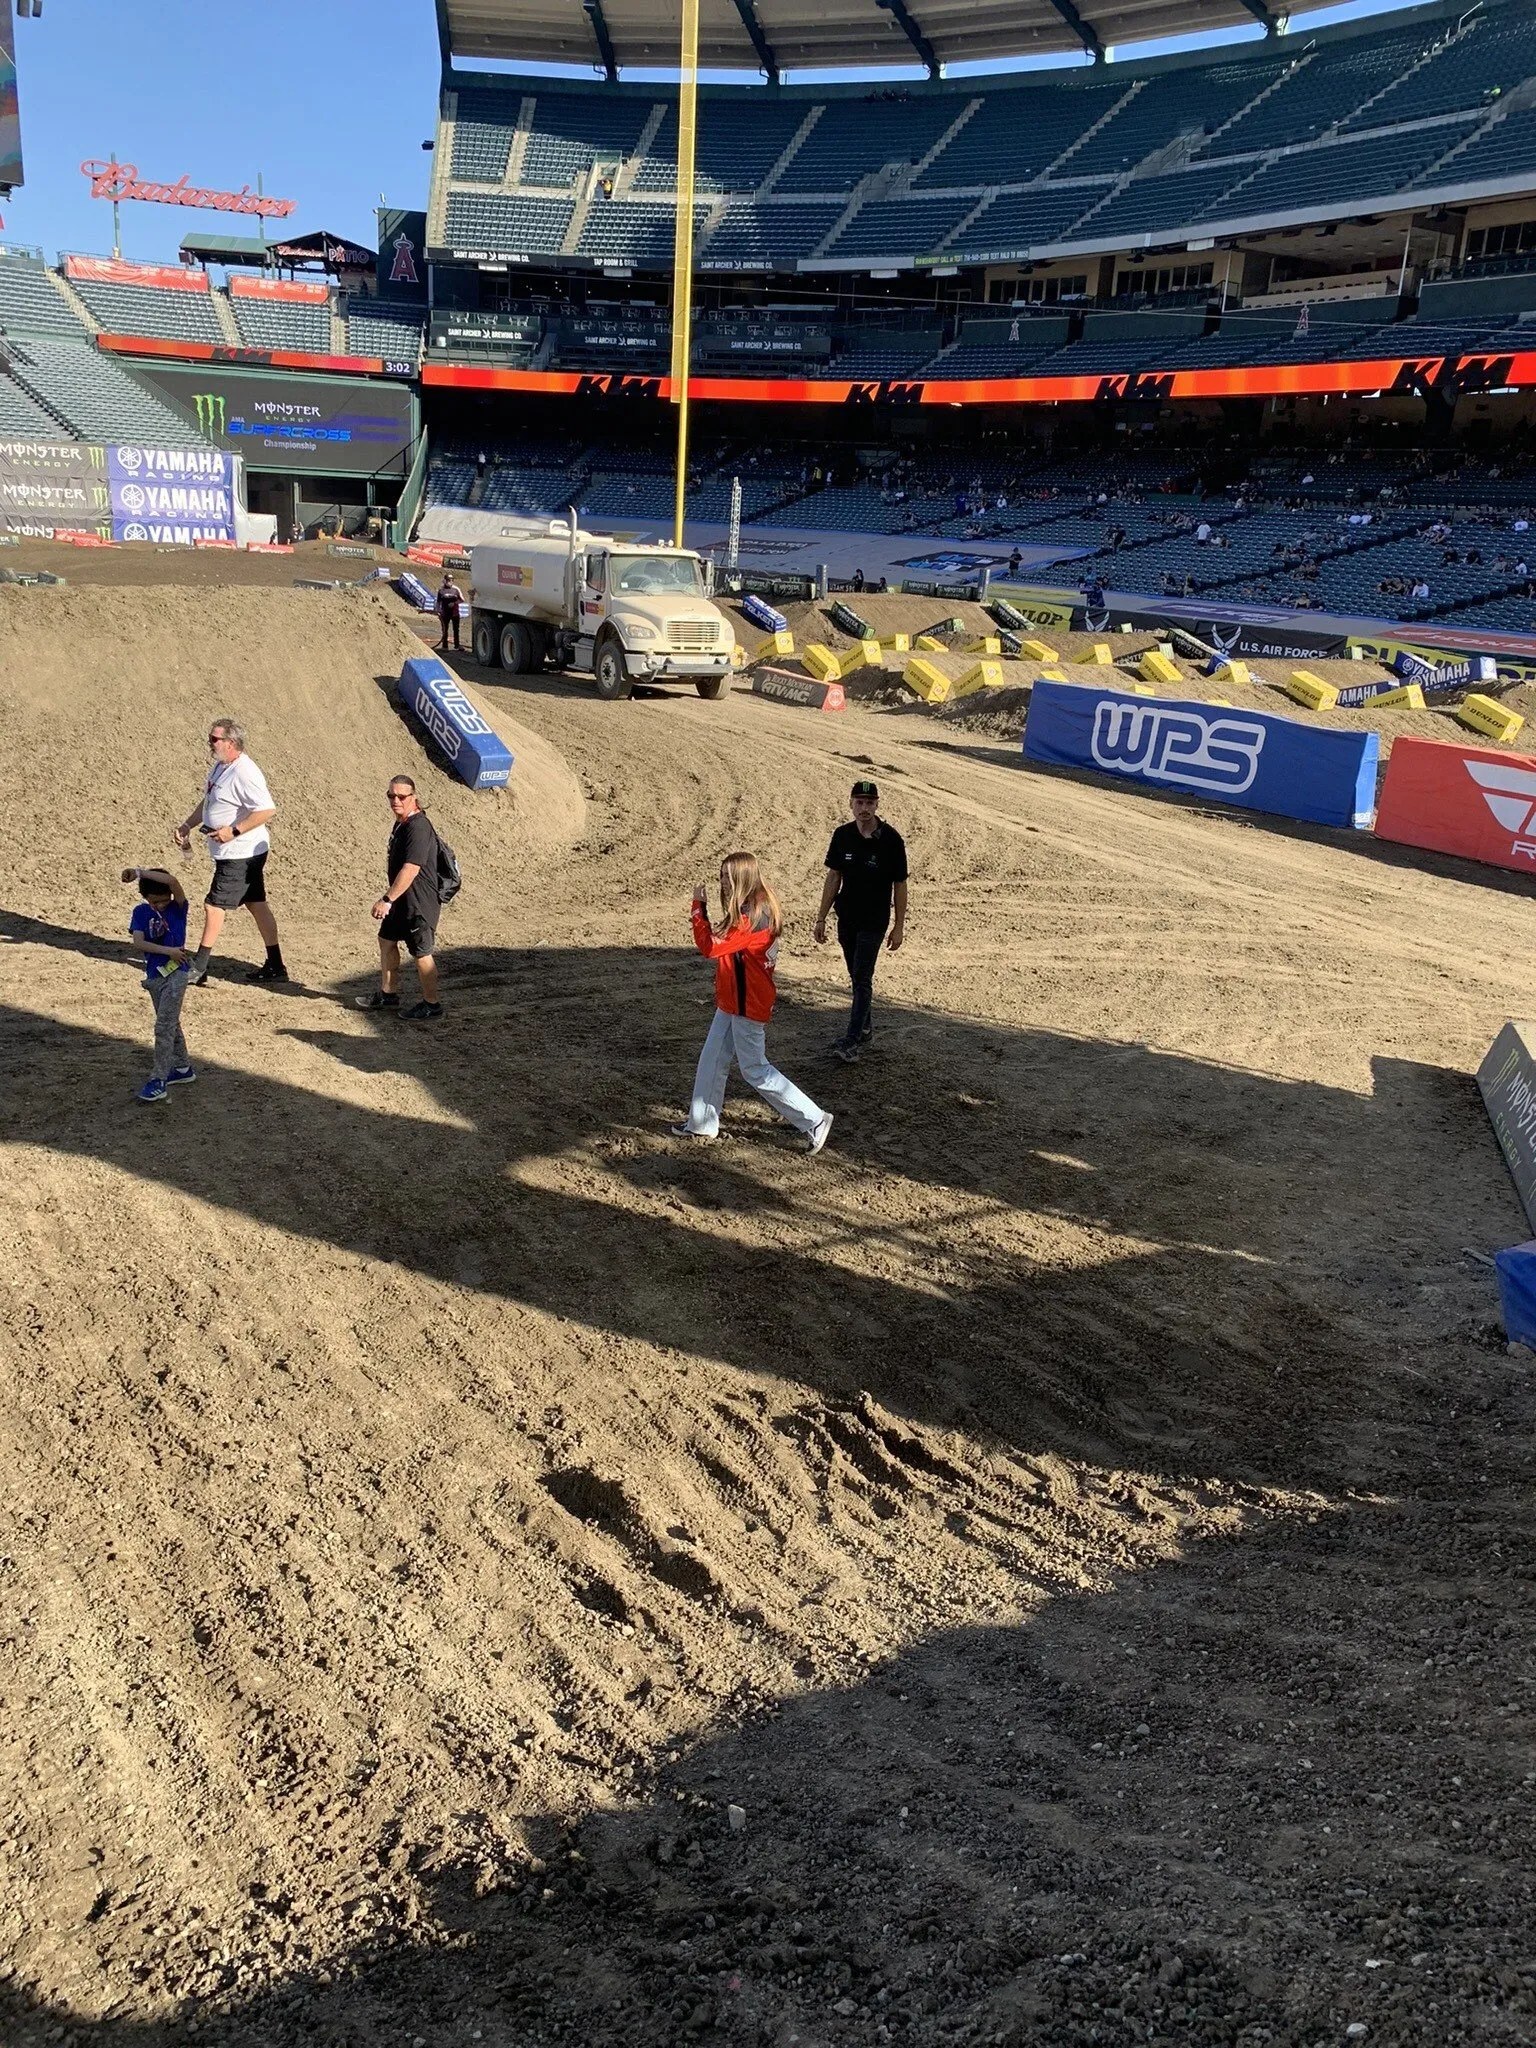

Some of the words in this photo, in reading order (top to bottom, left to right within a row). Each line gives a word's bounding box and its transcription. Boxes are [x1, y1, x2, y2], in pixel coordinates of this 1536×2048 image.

[80, 160, 298, 217] Budweiser
[328, 245, 370, 264] PATIO
[453, 251, 467, 259] SAINT
[468, 251, 488, 260] ARCHER
[498, 253, 520, 262] BREWING
[594, 258, 603, 266] TAP
[603, 258, 618, 267] ROOM
[624, 259, 638, 267] GRILL
[701, 261, 714, 269] SAINT
[715, 261, 733, 269] ARCHER
[743, 261, 764, 269] BREWING
[448, 328, 462, 336] SAINT
[462, 329, 481, 337] ARCHER
[491, 331, 514, 339] BREWING
[585, 336, 598, 344] SAINT
[599, 336, 617, 345] ARCHER
[626, 338, 648, 346] BREWING
[731, 341, 744, 349] SAINT
[745, 341, 763, 349] ARCHER
[772, 342, 793, 350] BREWING
[385, 361, 410, 373] 3:02
[1390, 356, 1515, 389] KTM
[574, 375, 662, 398] KTM
[844, 381, 925, 403] KTM
[1093, 373, 1176, 400] KTM
[254, 401, 321, 417] MONSTER
[231, 416, 245, 424] AMA
[228, 422, 352, 442] SUPERCROSS
[0, 442, 82, 461] MONSTER
[263, 439, 317, 451] Championship
[12, 458, 71, 468] ENERGY
[143, 449, 225, 474] YAMAHA
[128, 470, 220, 482] RACING
[3, 483, 86, 501] MONSTER
[145, 486, 228, 512] YAMAHA
[17, 500, 75, 508] ENERGY
[131, 509, 223, 520] RACING
[743, 601, 774, 628] FALKEN
[1240, 642, 1261, 653] U.S.
[1262, 643, 1283, 656] AIR
[909, 670, 931, 689] DUNLOP
[1422, 662, 1471, 686] YAMAHA
[1292, 684, 1320, 701] DUNLOP
[1425, 678, 1467, 693] ACING
[430, 679, 492, 735] WPS
[1373, 695, 1408, 709] DUNLOP
[415, 687, 461, 760] WPS
[1469, 707, 1505, 730] DUNLOP
[1091, 701, 1266, 794] WPS
[480, 770, 510, 781] WPS
[1495, 1111, 1522, 1169] ENERGY
